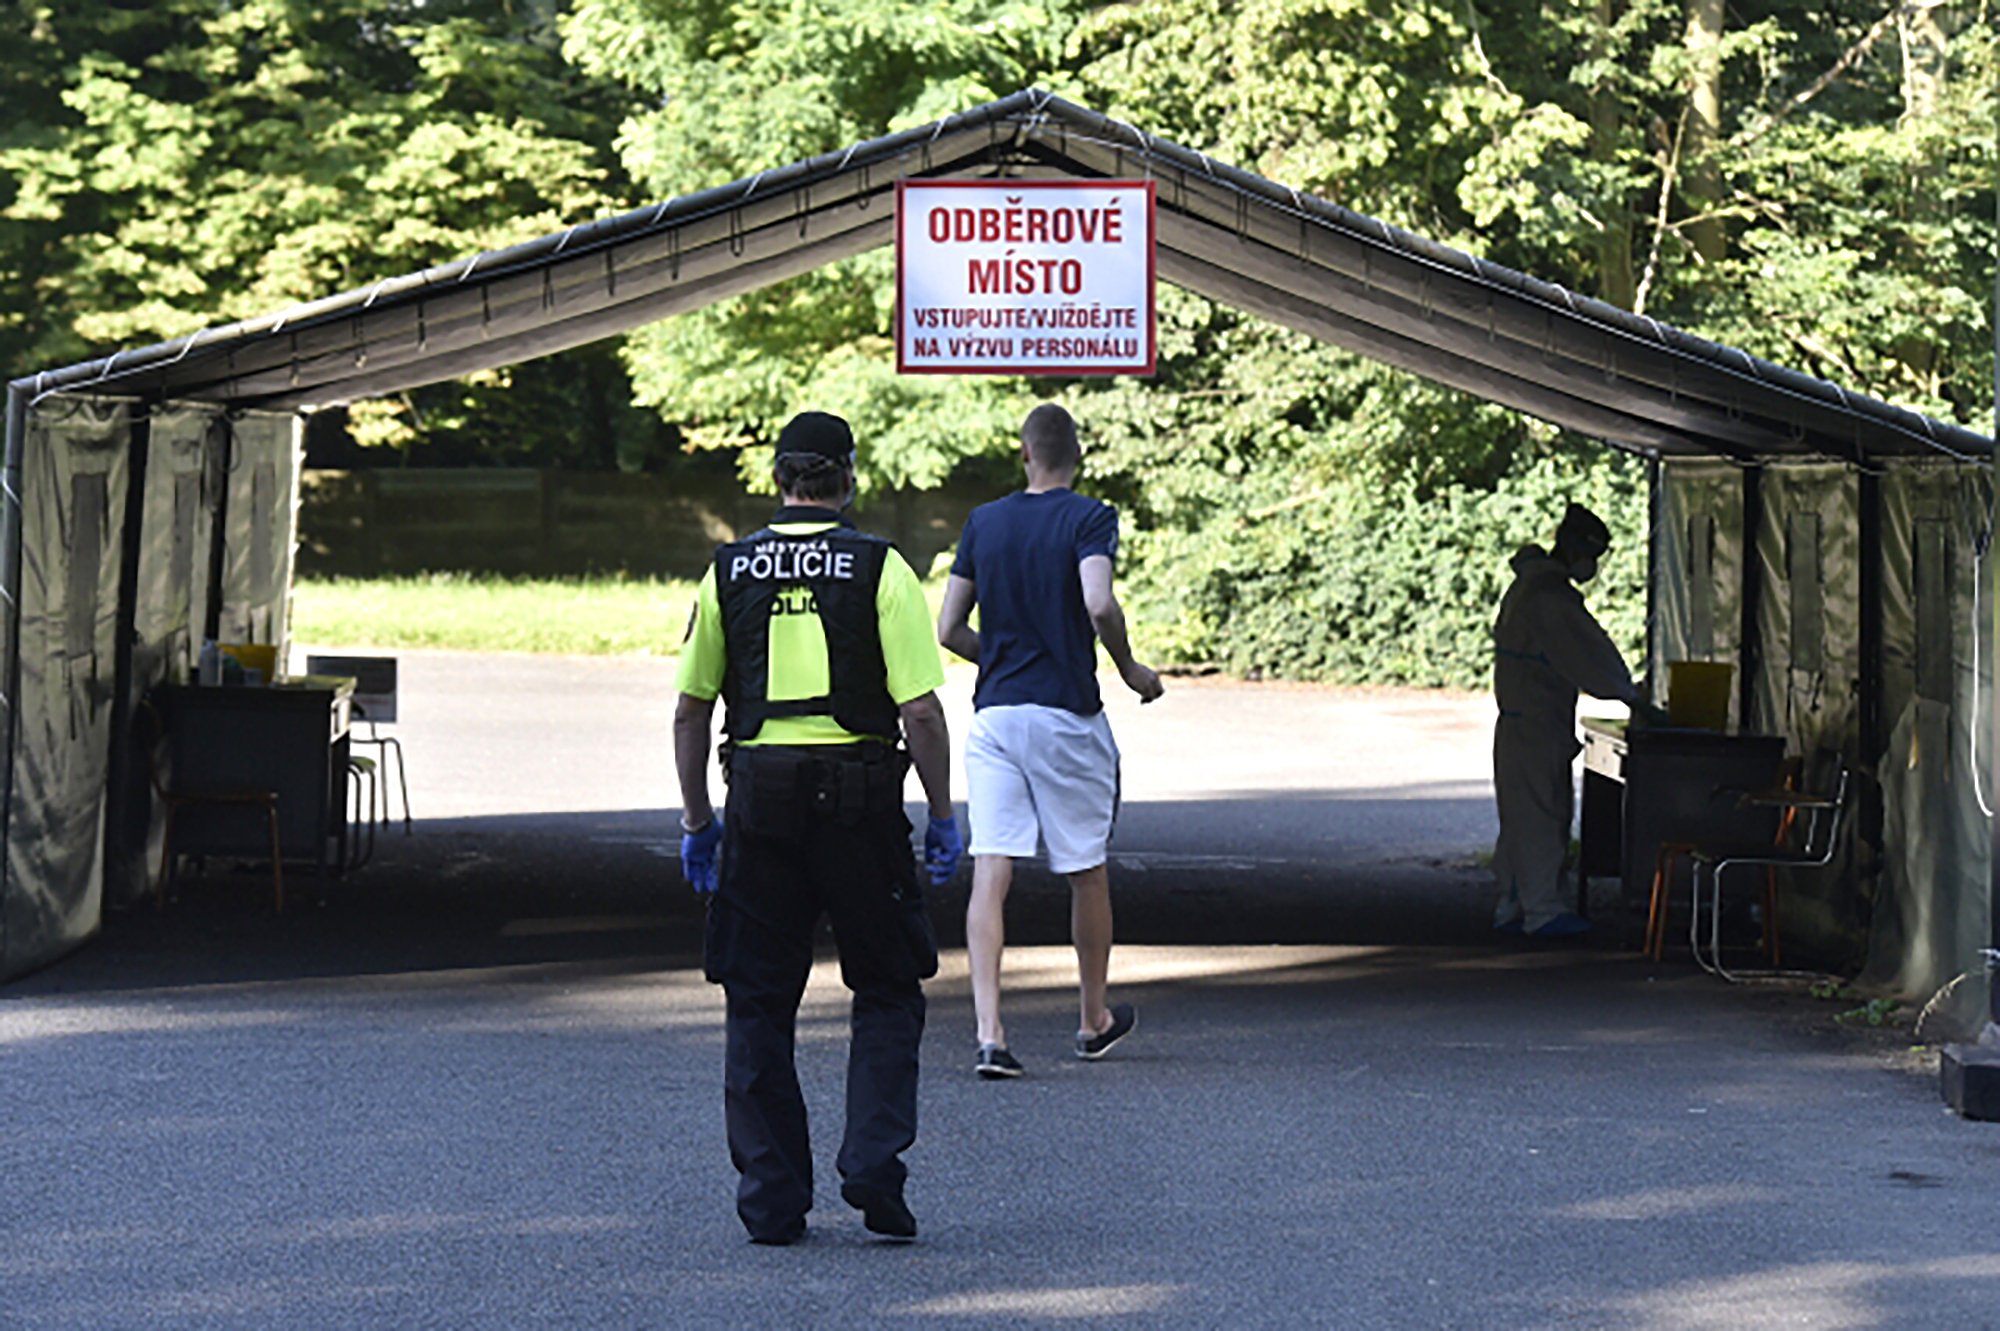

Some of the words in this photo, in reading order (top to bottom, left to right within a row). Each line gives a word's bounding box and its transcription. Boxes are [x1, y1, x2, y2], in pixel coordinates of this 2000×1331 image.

[929, 196, 1122, 243] ODBĚROVÉ
[968, 249, 1082, 295] MÍSTO
[913, 337, 941, 357] NA
[948, 332, 1013, 358] VÝZVU
[1021, 333, 1138, 358] PERSONÁLU
[730, 551, 854, 581] POLICIE
